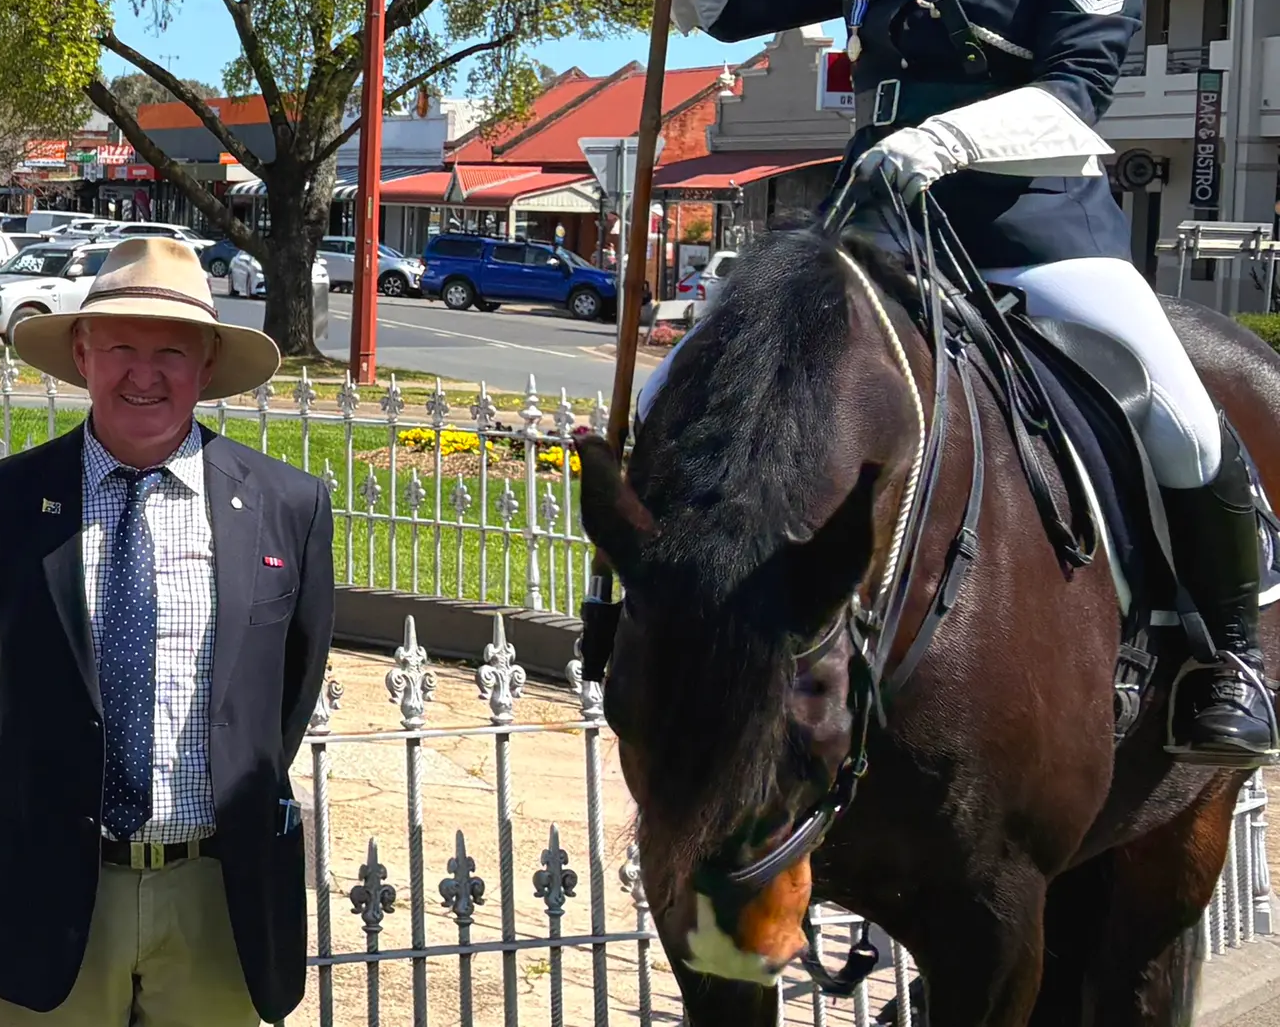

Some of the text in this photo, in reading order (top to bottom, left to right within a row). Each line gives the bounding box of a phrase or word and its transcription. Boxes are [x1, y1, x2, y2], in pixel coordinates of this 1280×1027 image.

[1196, 93, 1217, 200] BAR & BISTRO
